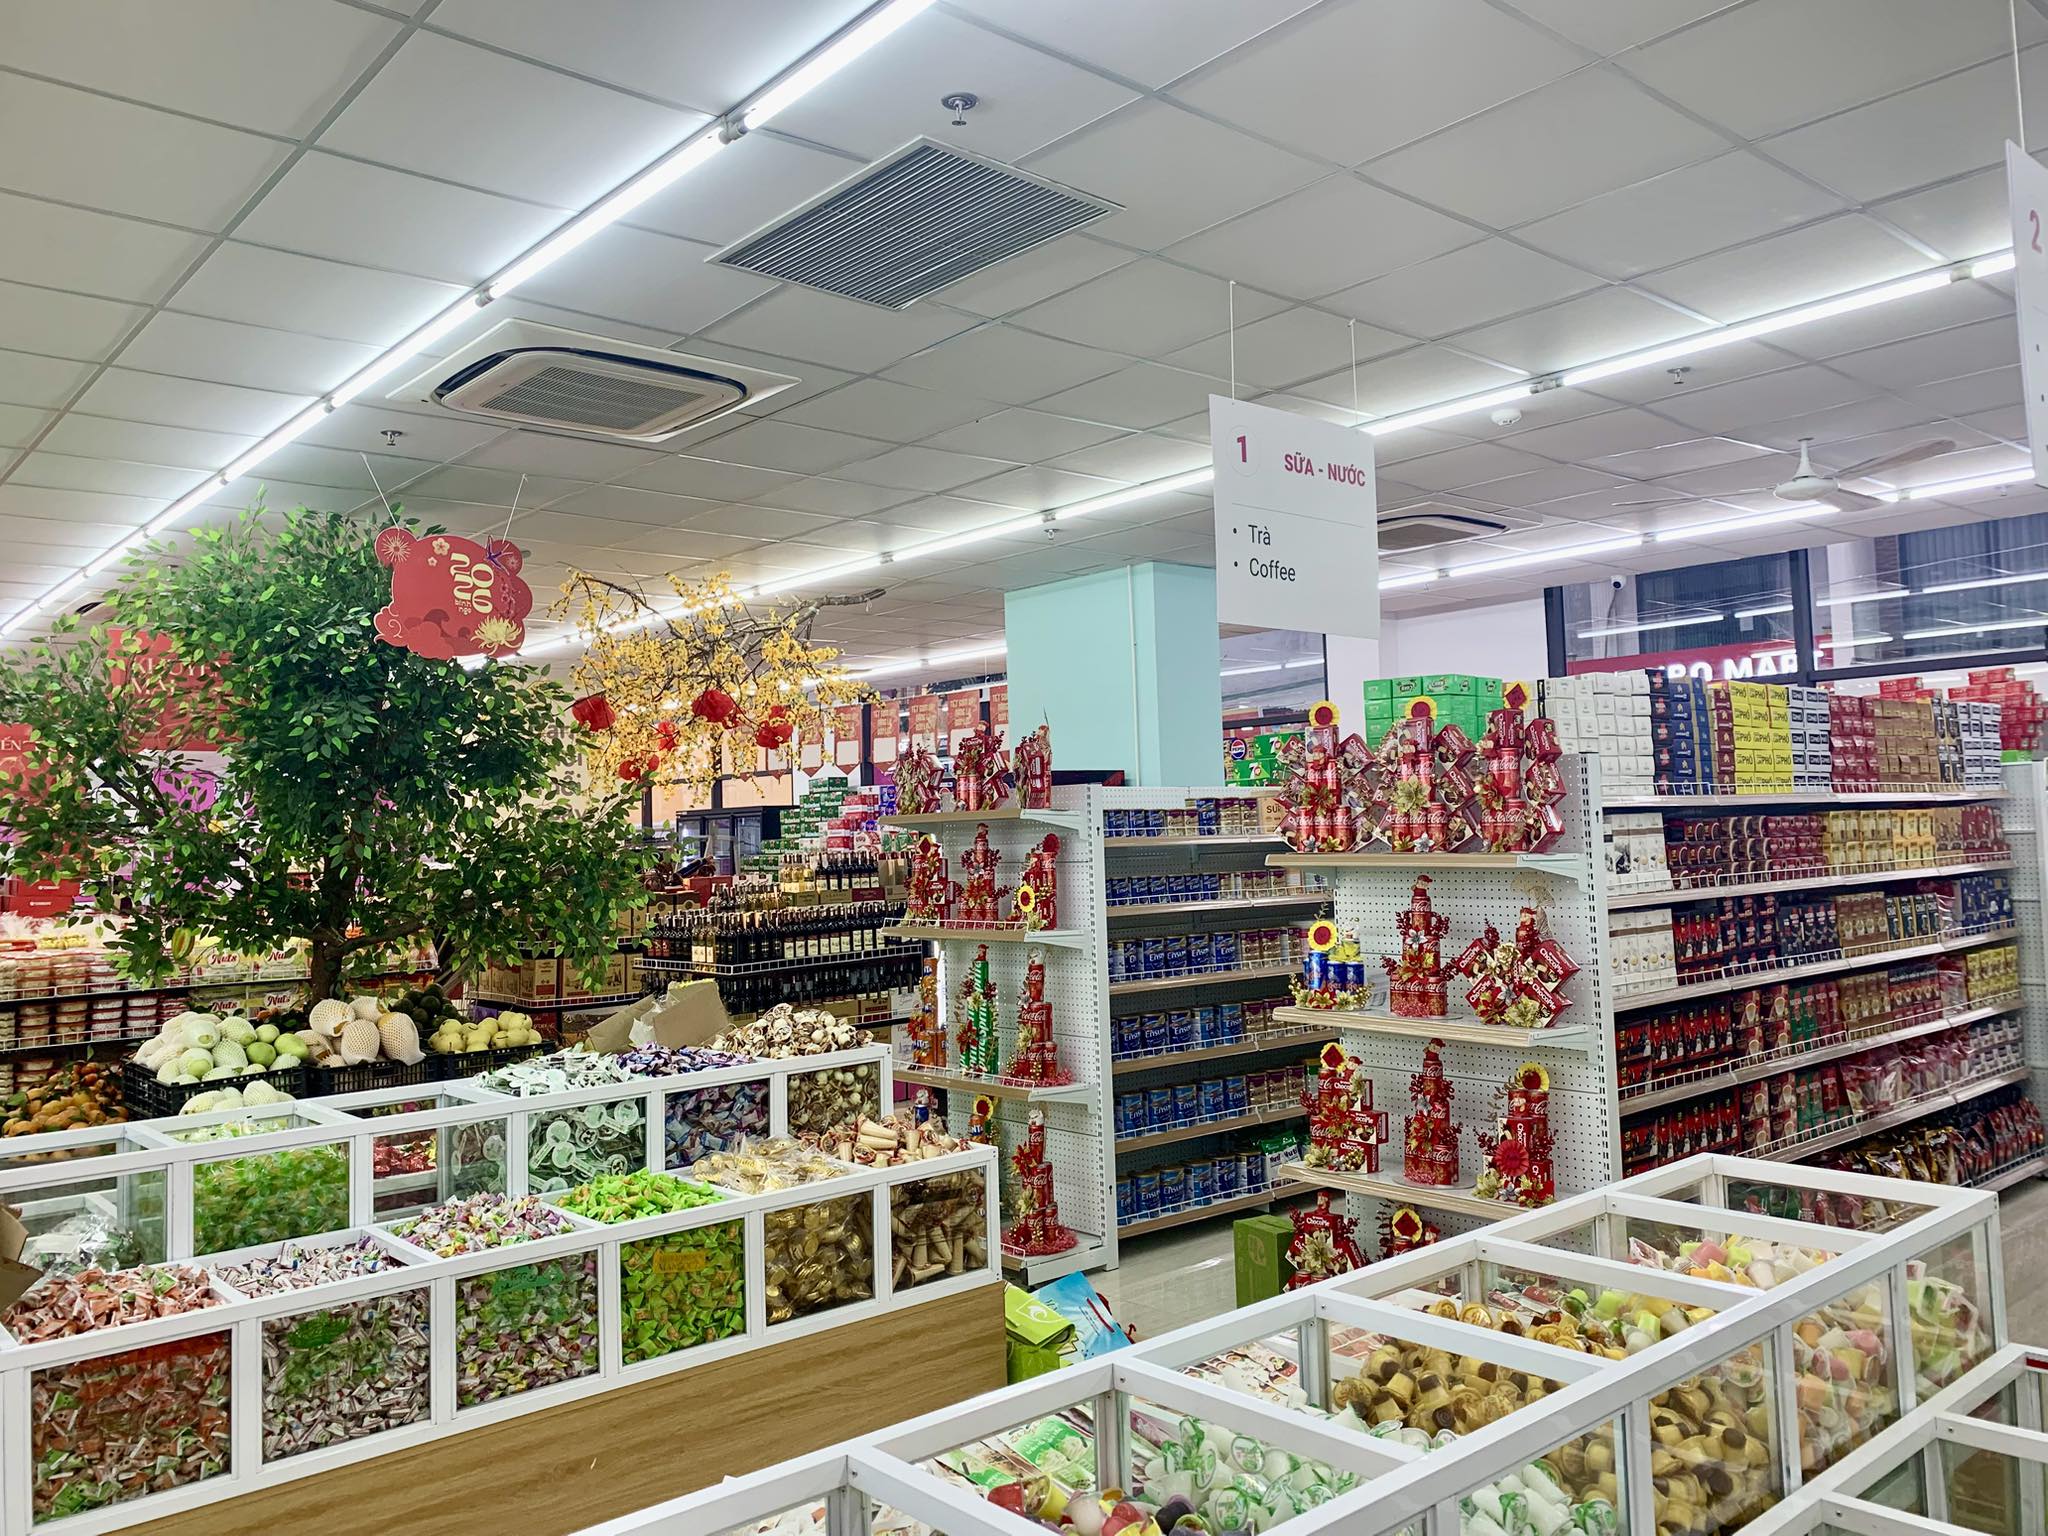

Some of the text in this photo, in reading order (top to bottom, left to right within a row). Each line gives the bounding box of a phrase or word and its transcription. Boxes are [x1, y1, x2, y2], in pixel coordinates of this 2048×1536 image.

[2029, 208, 2042, 254] 2
[1237, 435, 1248, 463] 1
[1284, 451, 1315, 477] SỮA
[1327, 463, 1366, 487] NƯỚC
[1248, 524, 1271, 546] Trà
[1249, 558, 1296, 582] Coffee
